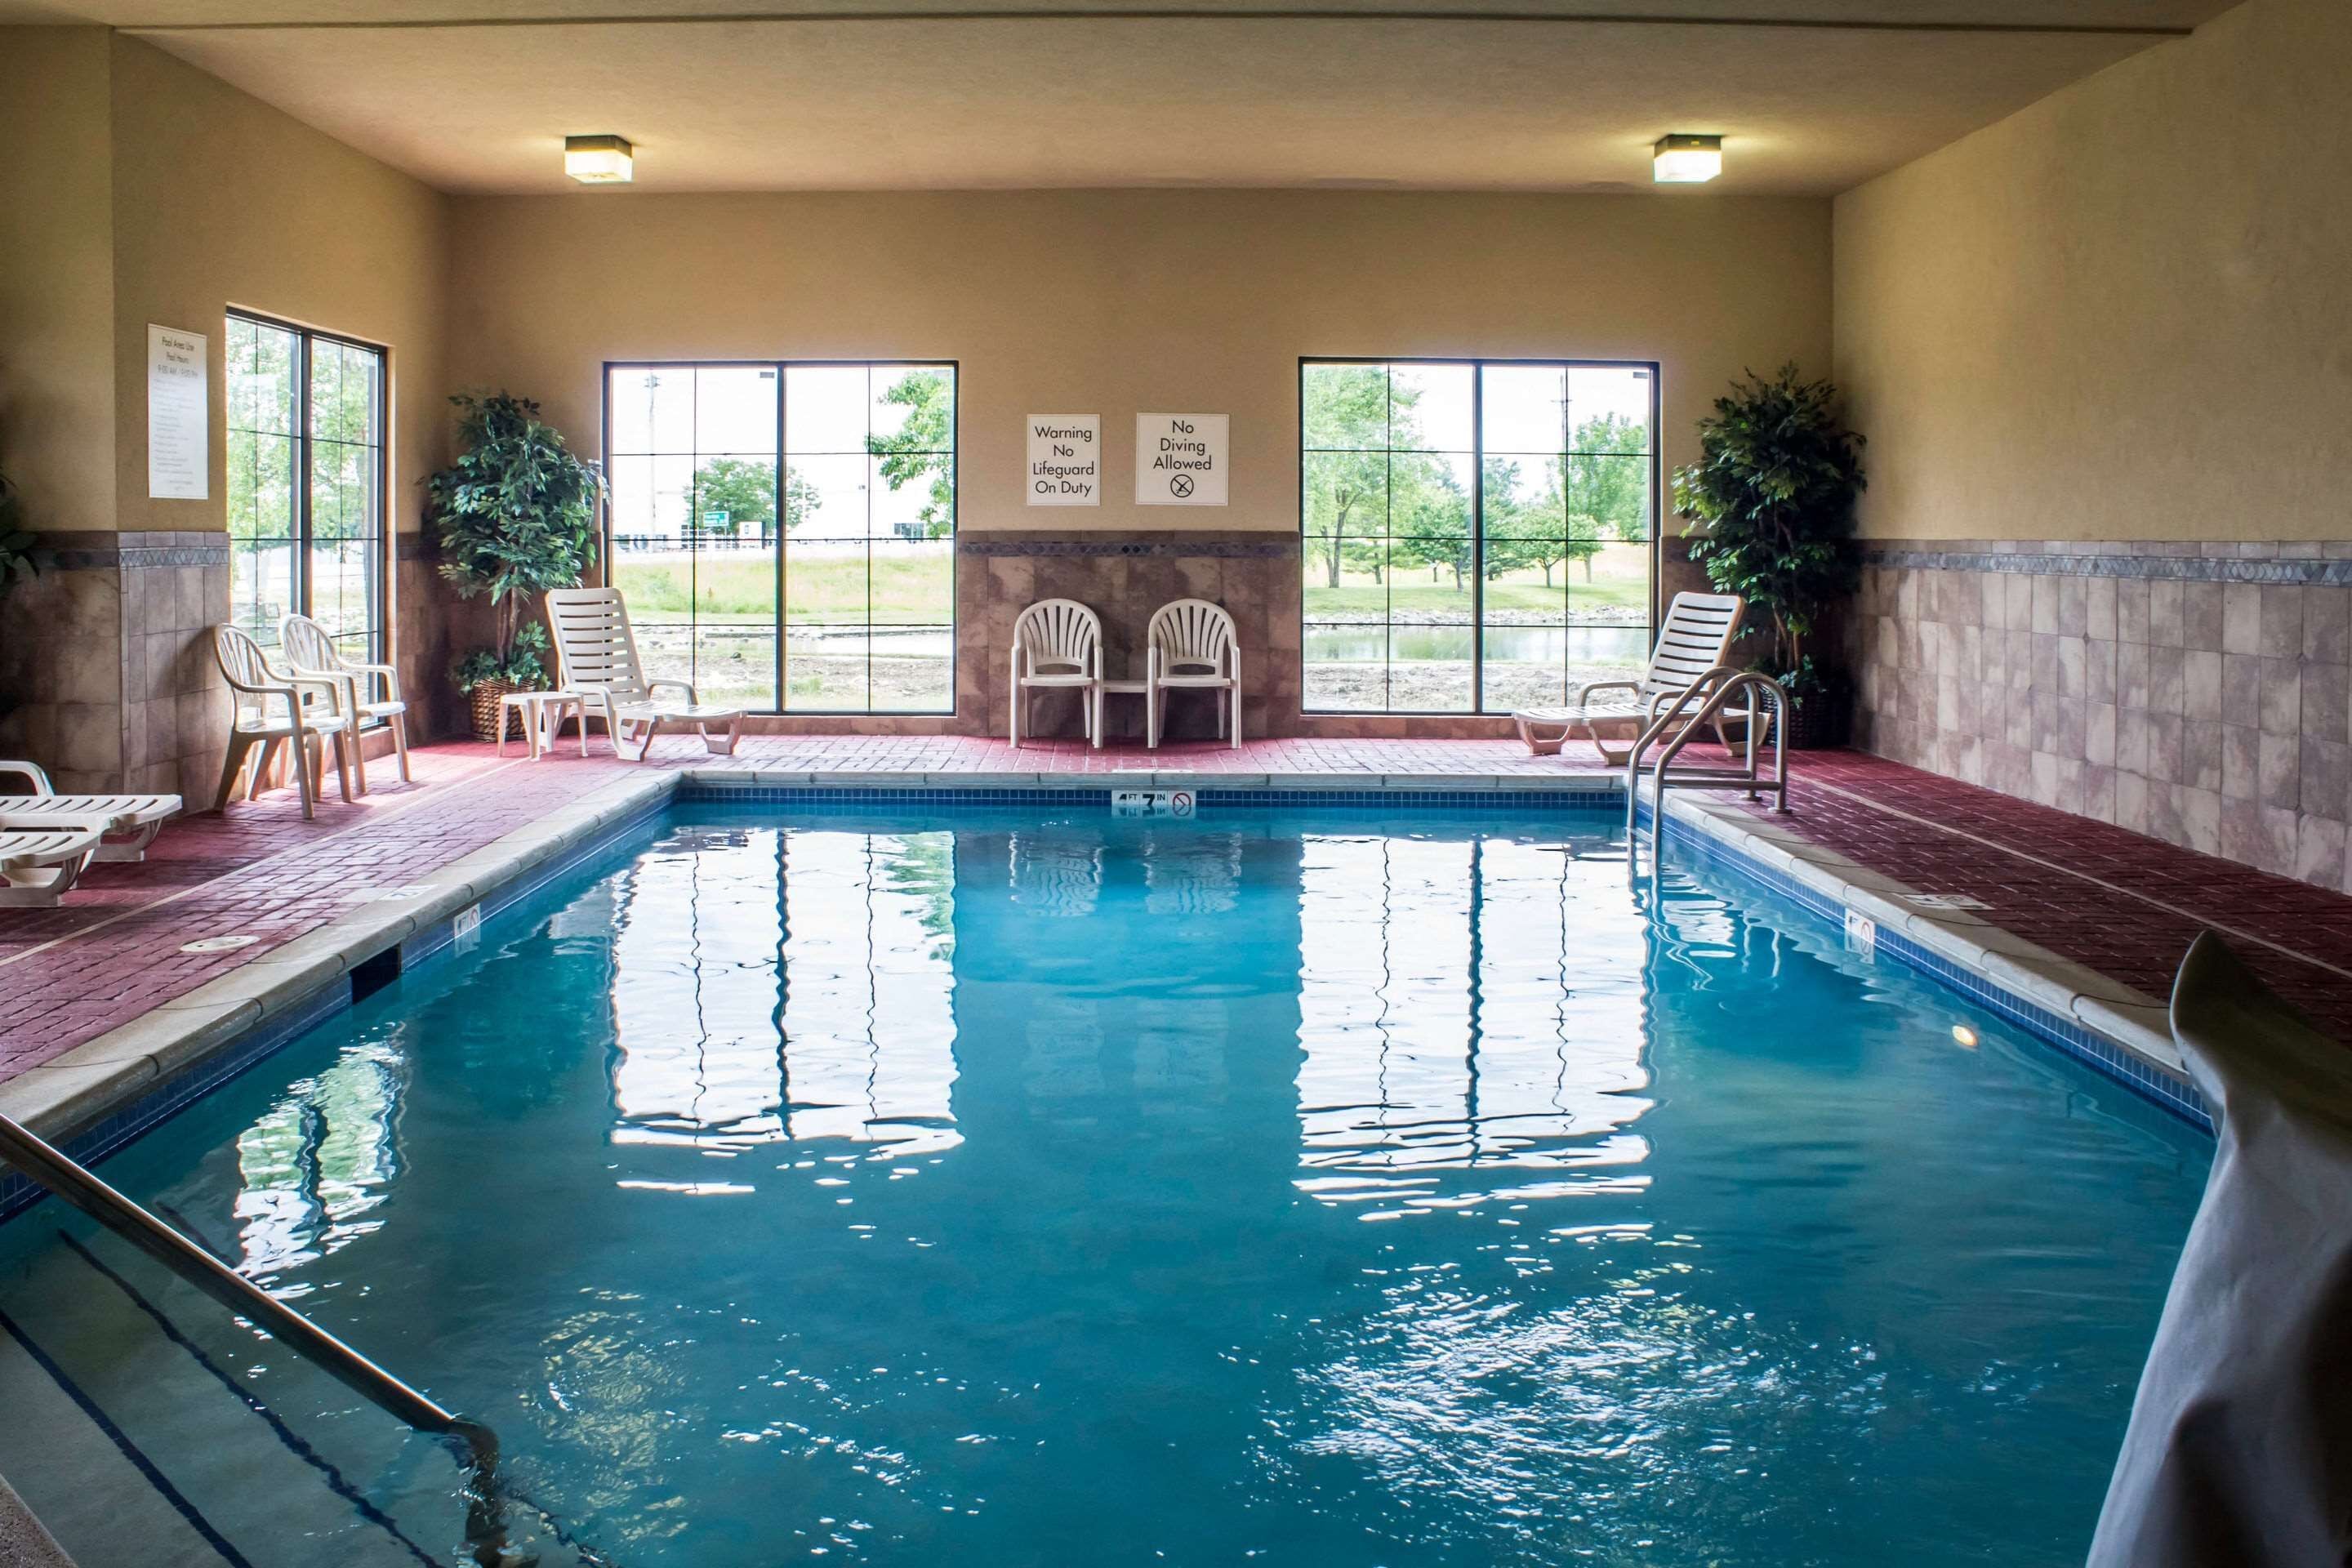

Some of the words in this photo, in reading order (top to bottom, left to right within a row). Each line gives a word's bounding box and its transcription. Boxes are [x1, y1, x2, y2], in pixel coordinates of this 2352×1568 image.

[1035, 425, 1092, 442] Warning
[1172, 420, 1194, 434] No
[1054, 444, 1074, 457] No
[1160, 438, 1205, 456] Diving
[1033, 461, 1094, 479] Lifeguard
[1153, 454, 1212, 470] Allowed
[1036, 480, 1056, 493] On
[1061, 480, 1092, 497] Duty
[1129, 793, 1137, 801] FT
[1156, 793, 1165, 801] IN
